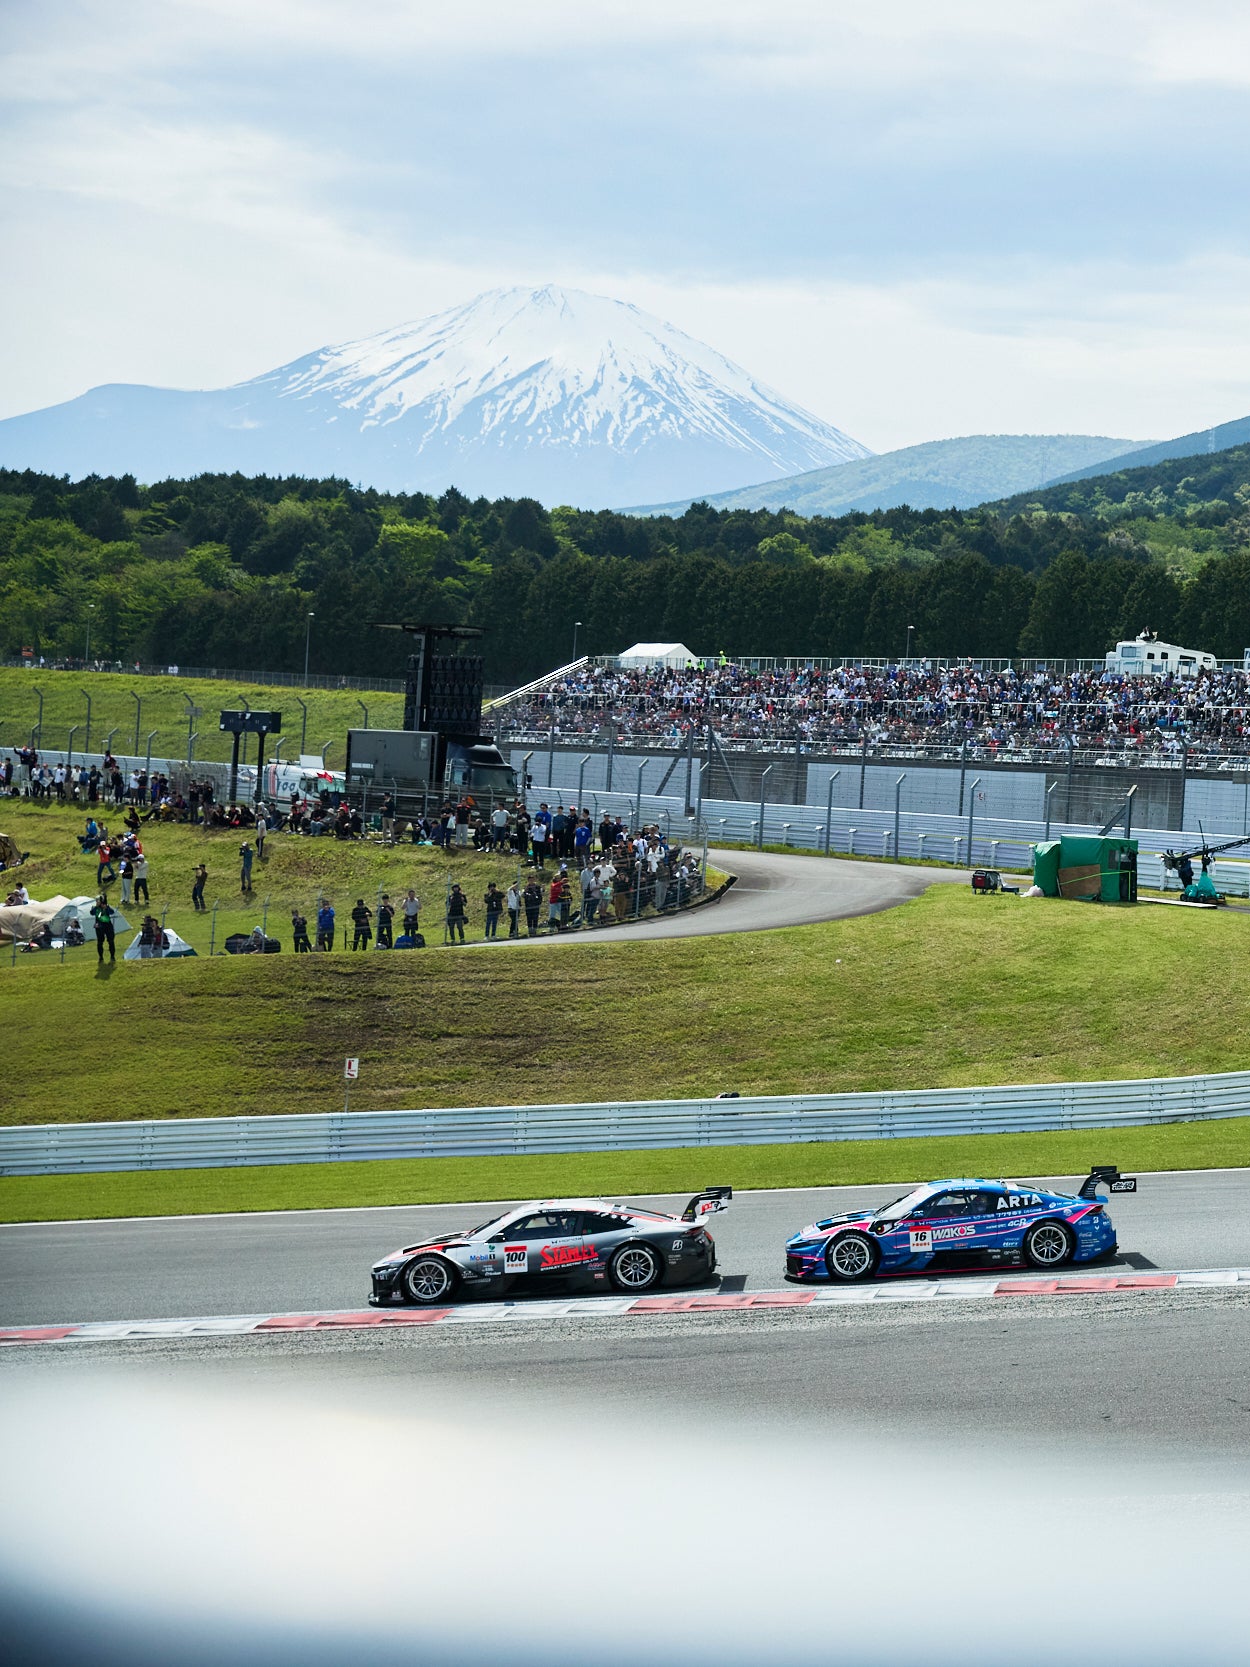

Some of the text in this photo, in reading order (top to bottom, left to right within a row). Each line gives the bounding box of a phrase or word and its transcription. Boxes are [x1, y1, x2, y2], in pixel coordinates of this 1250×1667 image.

[996, 1193, 1043, 1210] ARTA
[914, 1231, 927, 1241] 16
[506, 1251, 526, 1262] 100
[540, 1243, 599, 1267] STANLEY
